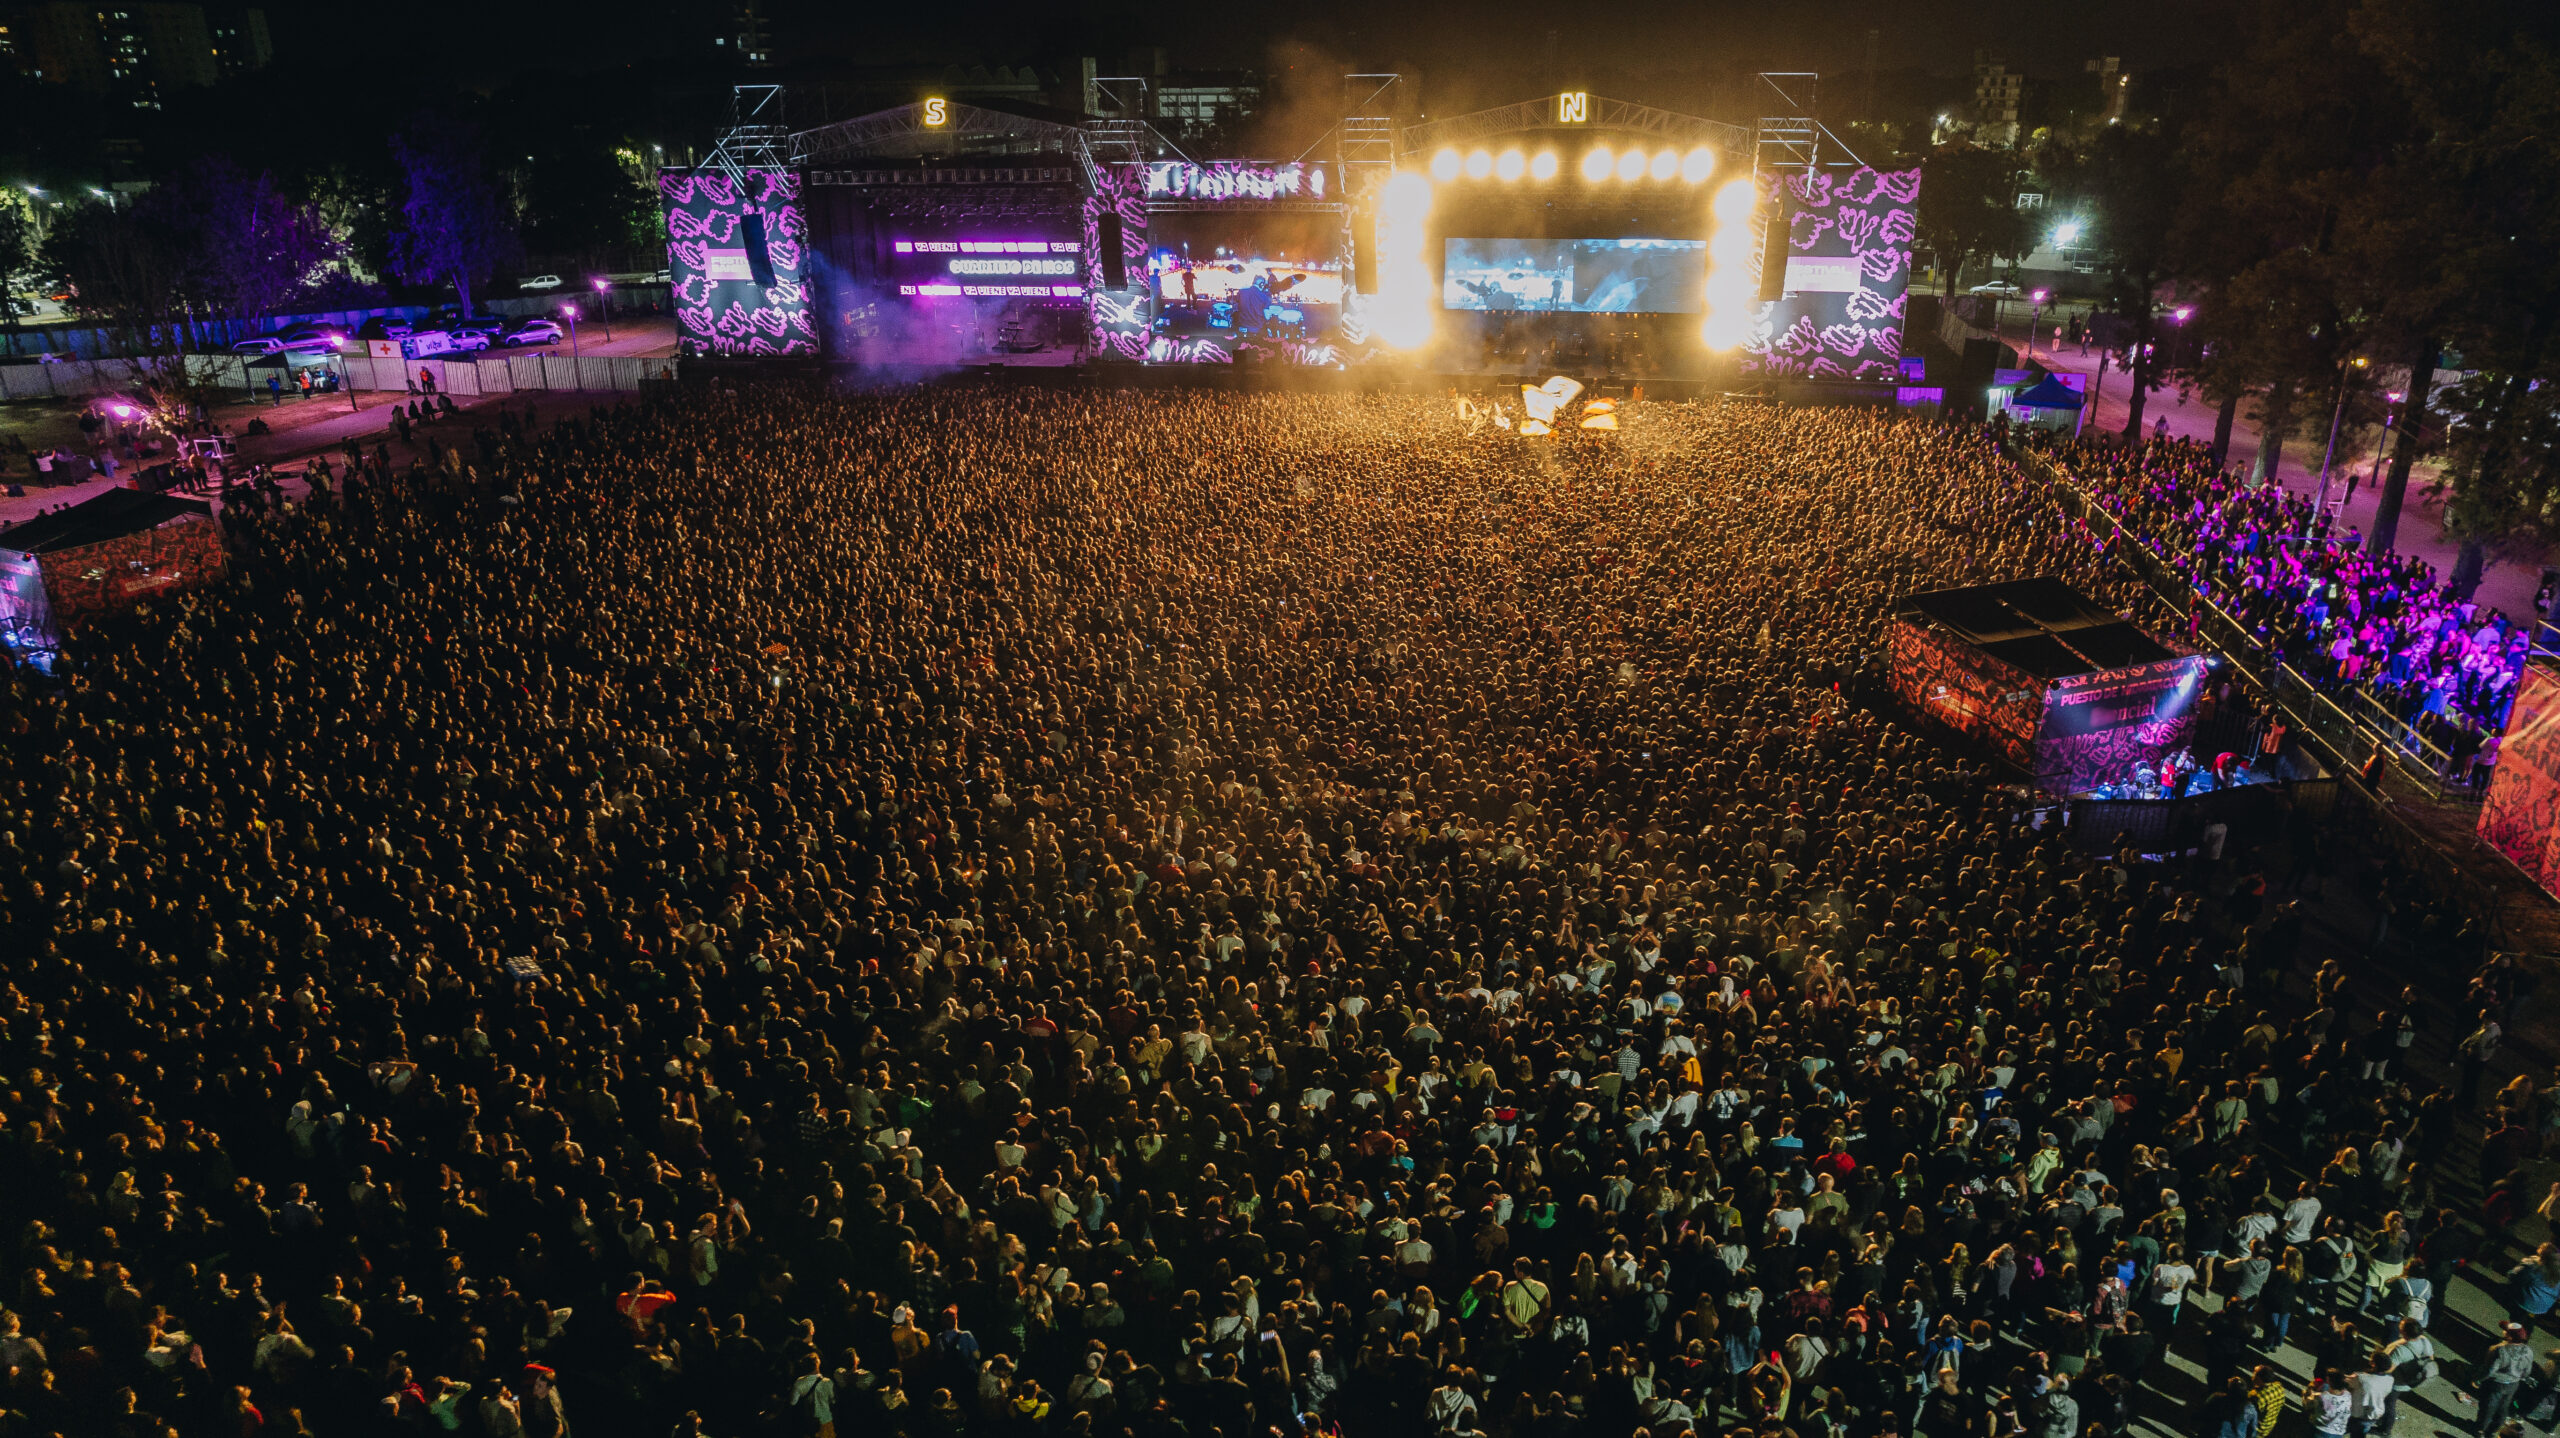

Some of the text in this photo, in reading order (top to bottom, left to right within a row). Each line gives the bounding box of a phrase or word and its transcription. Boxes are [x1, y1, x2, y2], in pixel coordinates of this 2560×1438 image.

[925, 98, 946, 125] S
[1560, 92, 1586, 122] N
[2060, 689, 2102, 706] PUESTO
[2103, 686, 2118, 698] DE
